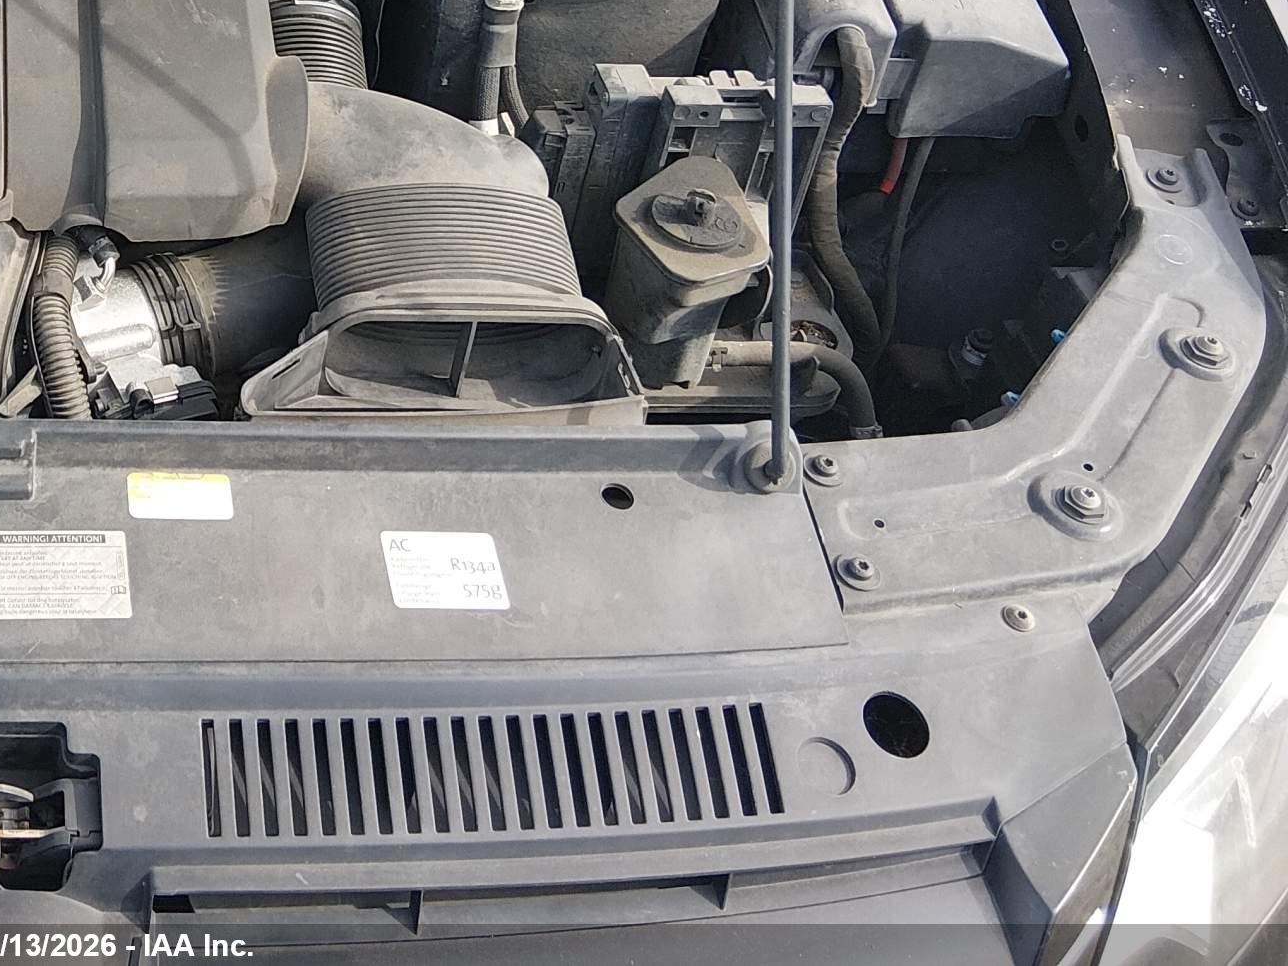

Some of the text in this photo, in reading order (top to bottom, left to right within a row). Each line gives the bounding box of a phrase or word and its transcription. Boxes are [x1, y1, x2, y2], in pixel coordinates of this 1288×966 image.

[51, 535, 103, 543] ATTENTION!
[389, 538, 412, 553] AC
[450, 557, 496, 575] R134a
[463, 584, 503, 600] 575g
